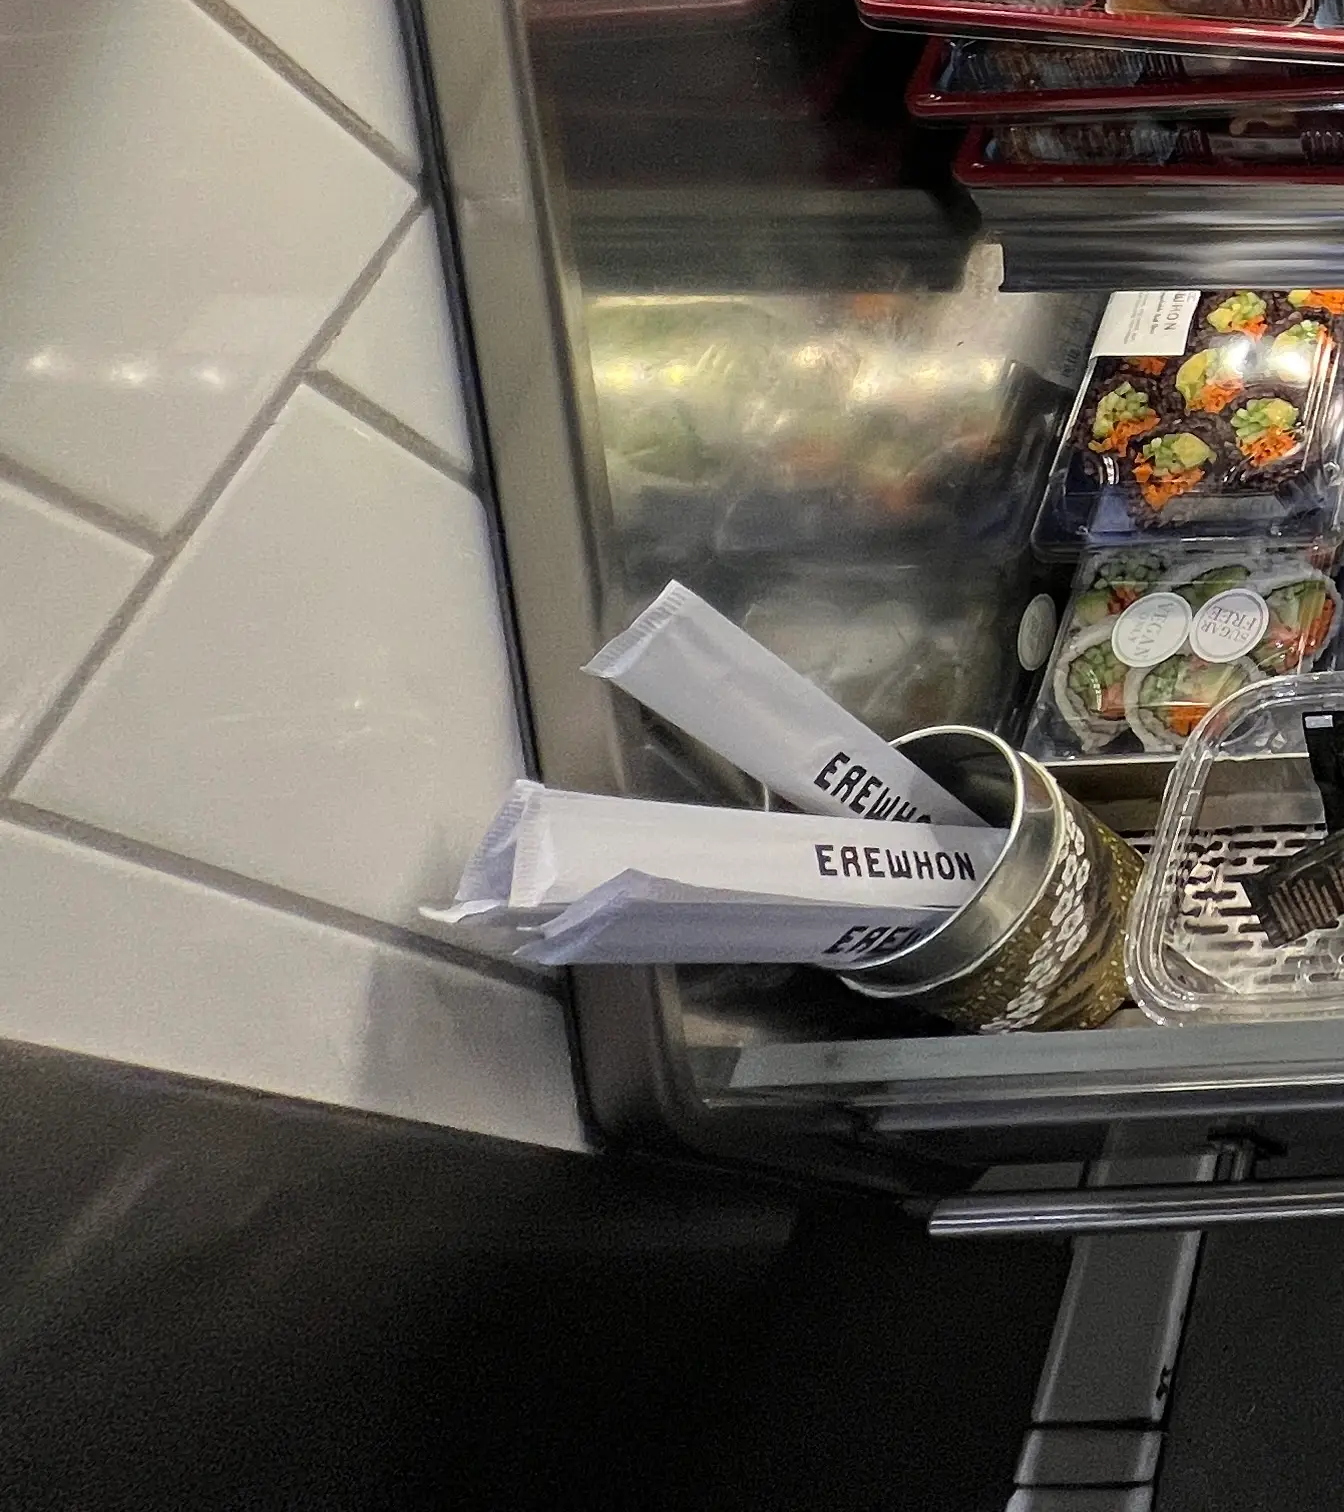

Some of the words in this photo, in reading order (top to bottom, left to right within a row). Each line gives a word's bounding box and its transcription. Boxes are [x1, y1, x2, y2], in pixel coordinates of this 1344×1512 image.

[1164, 293, 1184, 331] WHON
[1134, 602, 1176, 659] VEGAN
[1201, 619, 1250, 643] SUGAR
[1208, 605, 1257, 630] FREE
[813, 751, 931, 824] EREWH
[814, 844, 977, 881] EREWHON
